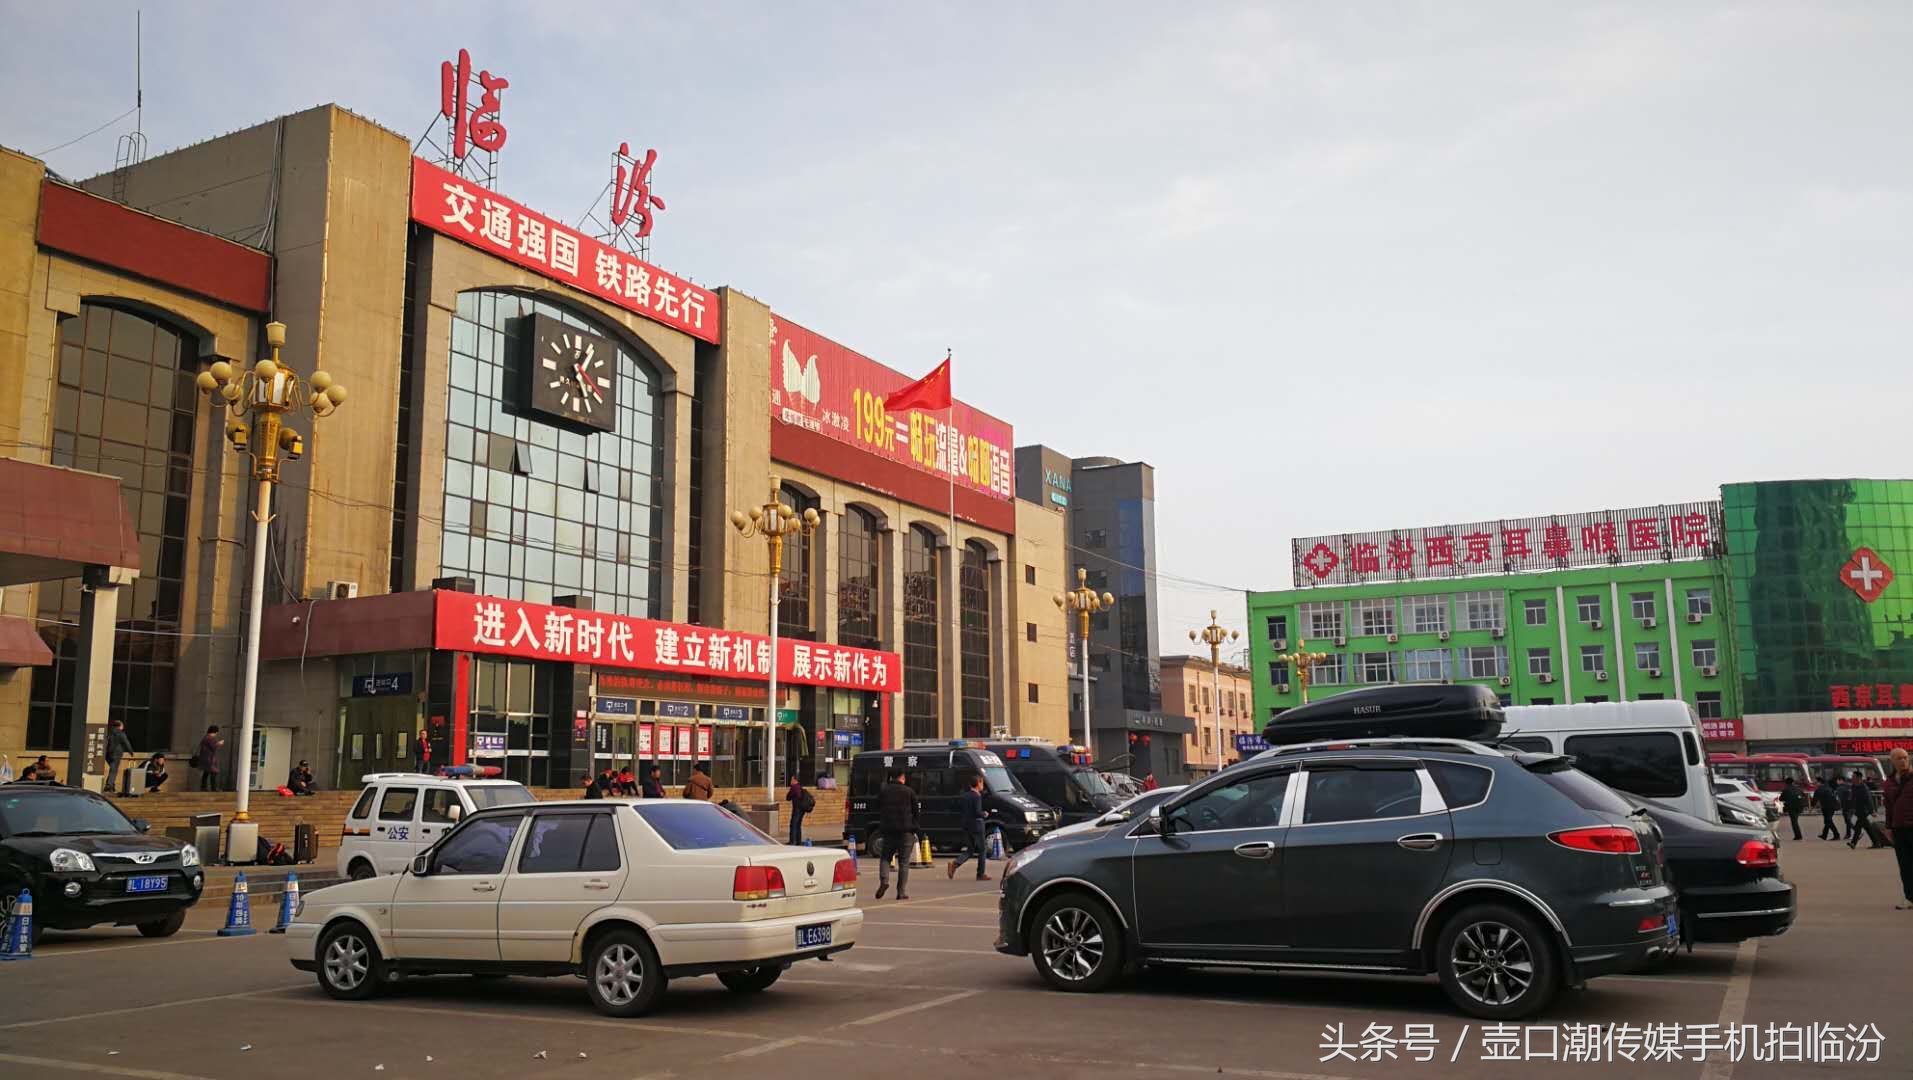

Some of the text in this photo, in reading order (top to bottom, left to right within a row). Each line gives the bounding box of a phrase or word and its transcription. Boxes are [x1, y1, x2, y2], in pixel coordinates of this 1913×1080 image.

[440, 48, 666, 238] 临 汾
[442, 182, 707, 328] 交通强国 铁路先行
[1349, 513, 1709, 573] 临汾西京耳鼻喉医院
[473, 601, 634, 662] 进入新时代
[655, 625, 771, 674] 建立新机制
[792, 642, 888, 687] 展示新作为
[1353, 706, 1381, 715] HASUR
[884, 756, 918, 767] 警察
[388, 826, 409, 840] 公安
